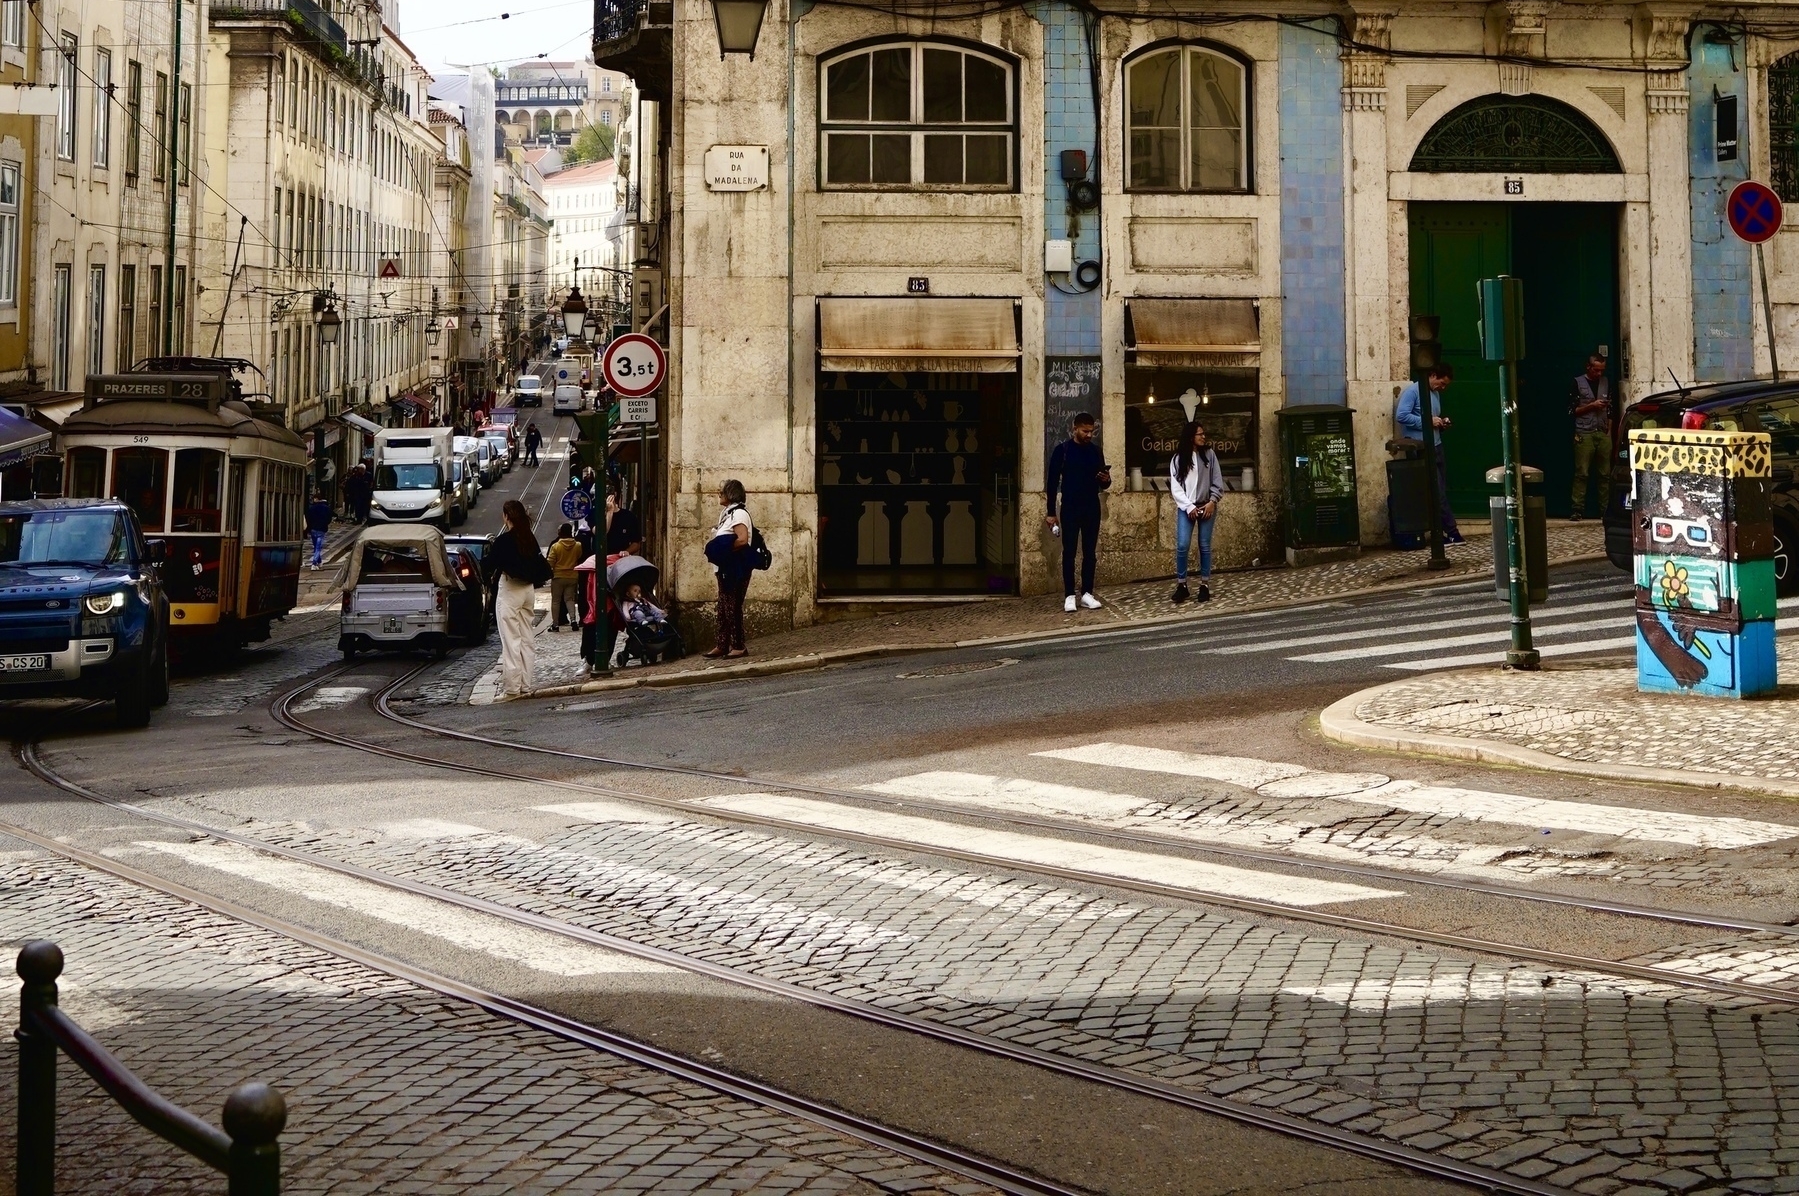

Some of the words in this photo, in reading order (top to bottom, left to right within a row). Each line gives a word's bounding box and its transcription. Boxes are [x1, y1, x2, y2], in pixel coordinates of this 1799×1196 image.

[729, 151, 744, 159] RUA
[731, 164, 742, 172] DA
[714, 176, 758, 185] MADALENA
[1508, 181, 1520, 194] 85
[855, 359, 865, 371] LA
[870, 359, 912, 371] FABBRICA
[916, 359, 942, 371] DELLA
[1150, 354, 1184, 366] GELATO
[104, 384, 166, 395] PRAZERES
[181, 383, 203, 398] 28
[1048, 381, 1090, 398] GELATO
[133, 435, 149, 444] 549
[12, 657, 28, 669] CS
[29, 656, 44, 668] 20
